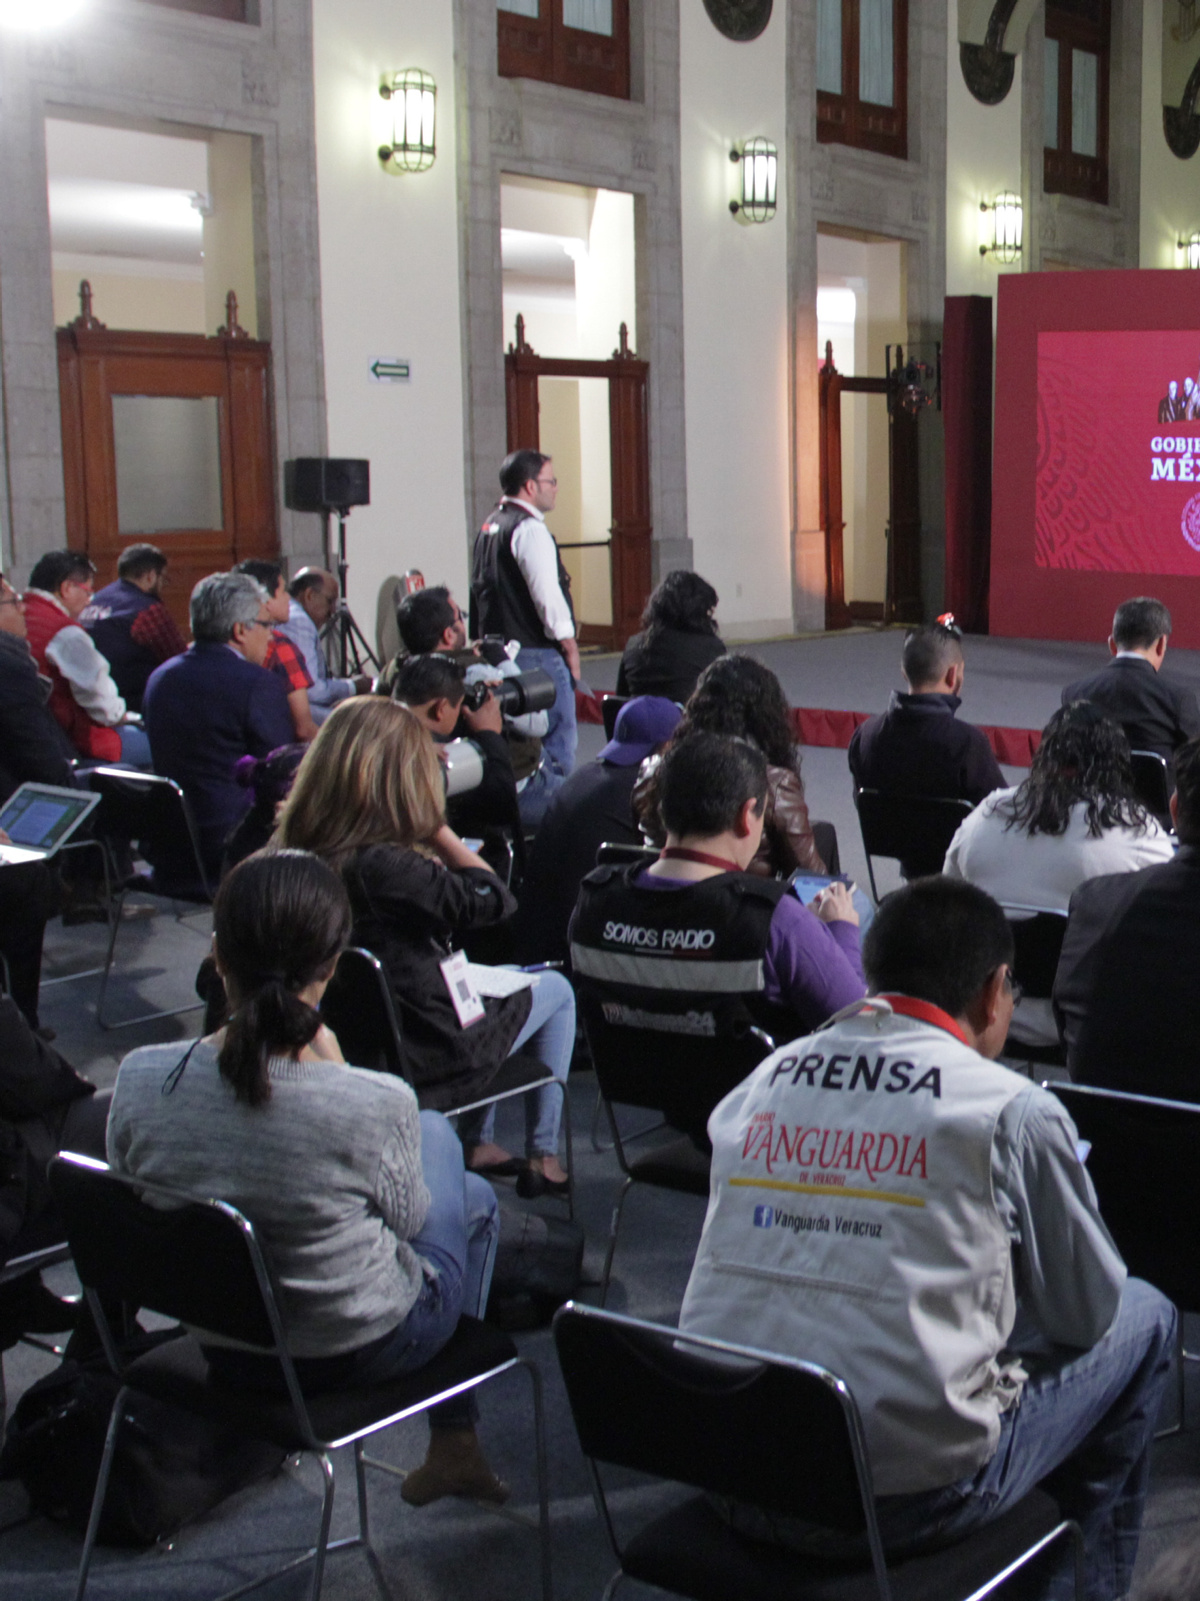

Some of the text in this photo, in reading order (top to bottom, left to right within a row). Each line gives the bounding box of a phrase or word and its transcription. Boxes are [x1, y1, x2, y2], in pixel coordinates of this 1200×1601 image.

[603, 921, 715, 949] SOMOS RADIO
[769, 1054, 941, 1099] PRENSA
[741, 1123, 929, 1182] VANGUARDIA
[799, 1171, 846, 1187] DE VERACRUZ
[774, 1209, 830, 1234] Vanguardia
[835, 1215, 882, 1239] Veracruz
